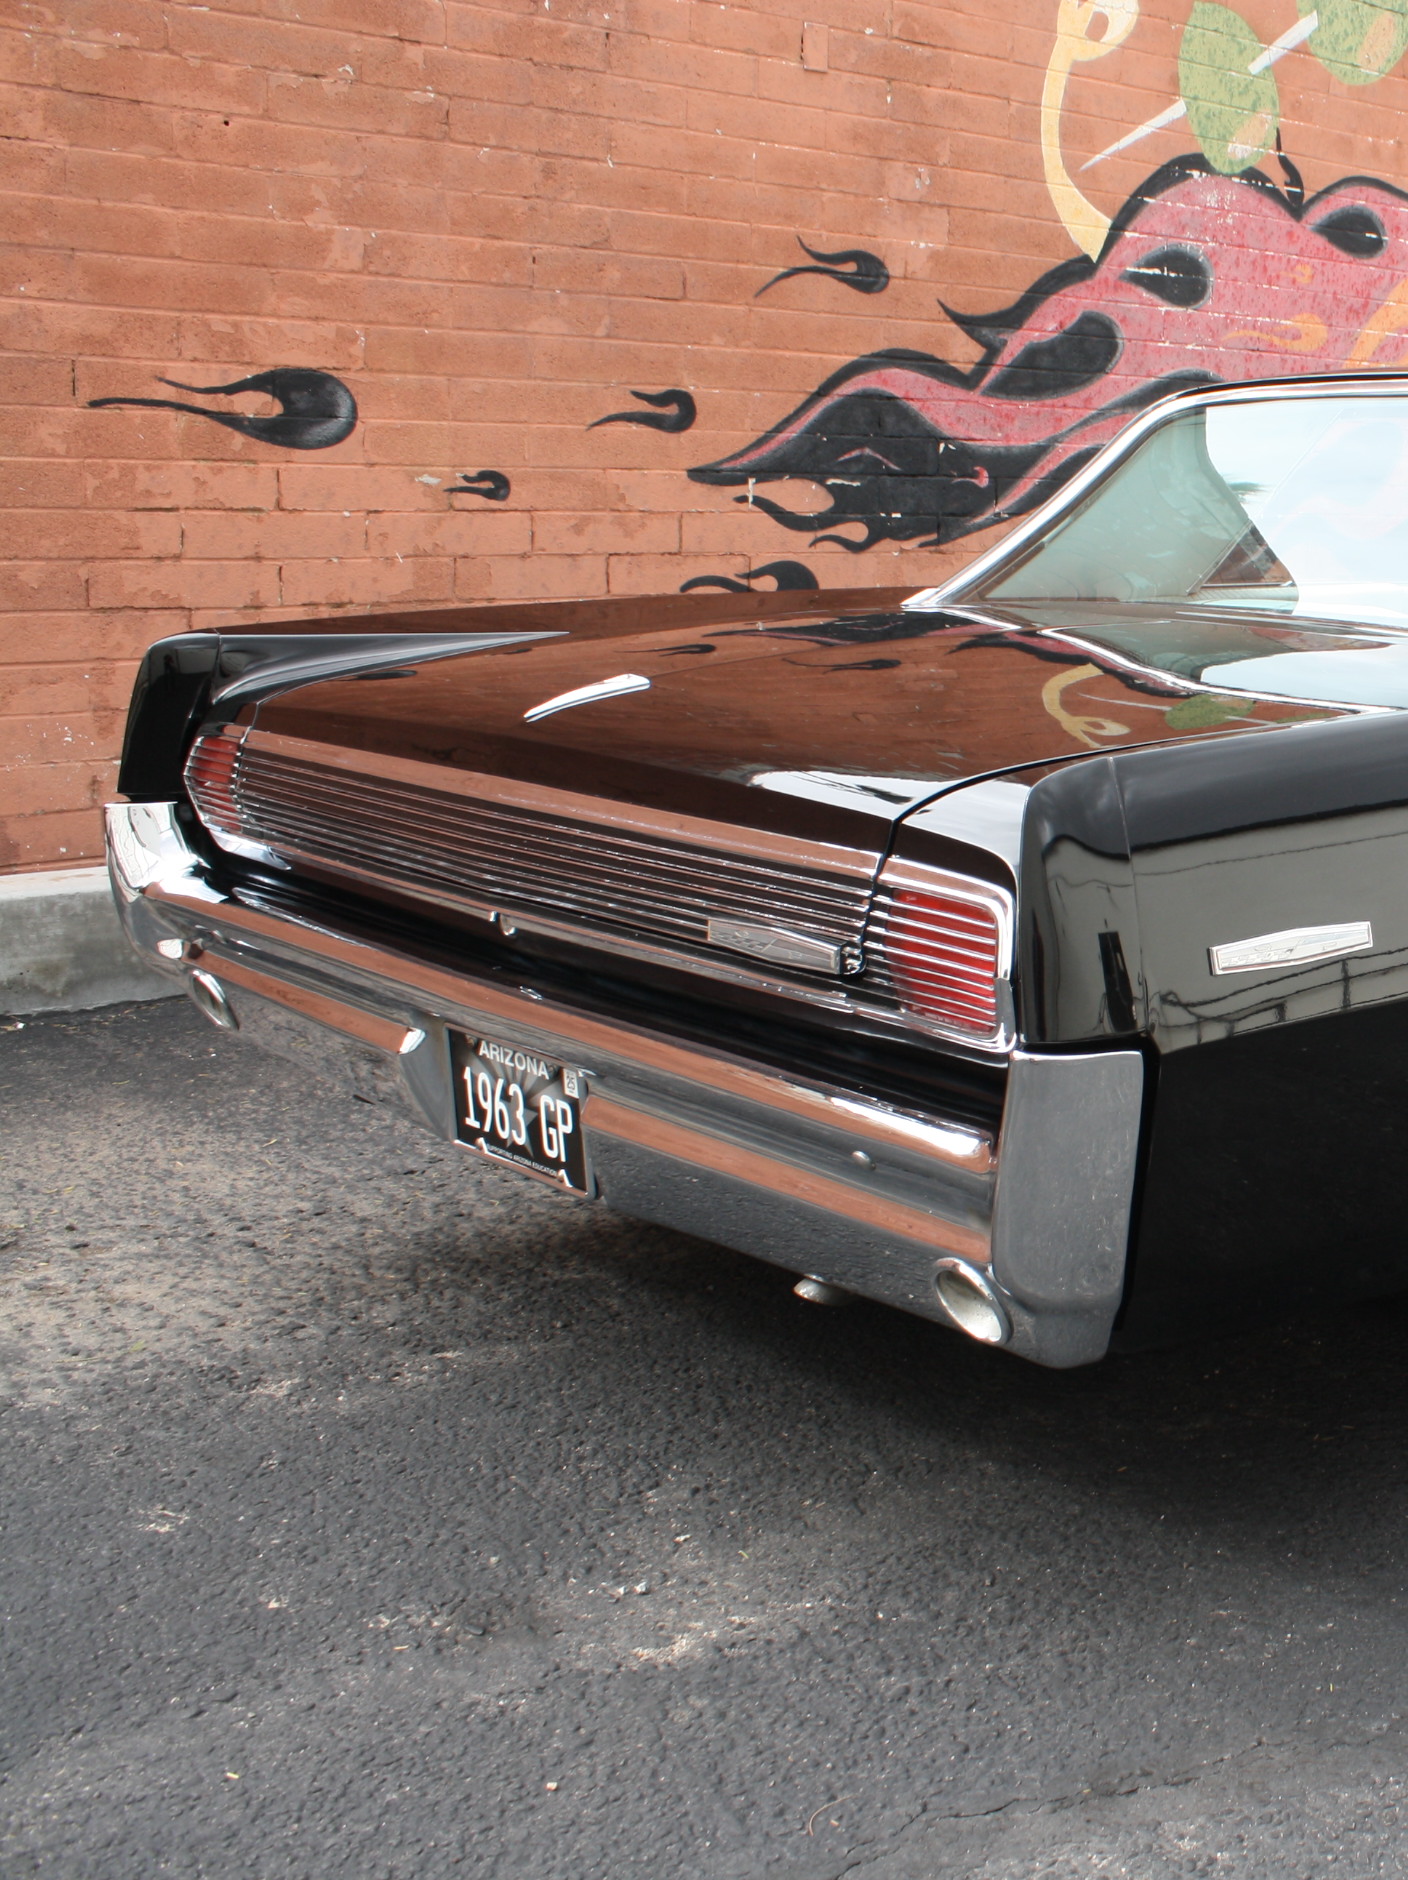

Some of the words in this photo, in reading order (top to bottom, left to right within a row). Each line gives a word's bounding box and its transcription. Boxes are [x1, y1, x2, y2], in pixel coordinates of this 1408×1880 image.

[478, 1039, 550, 1080] ARIZONA
[462, 1065, 527, 1146] 1963
[540, 1094, 573, 1162] GP
